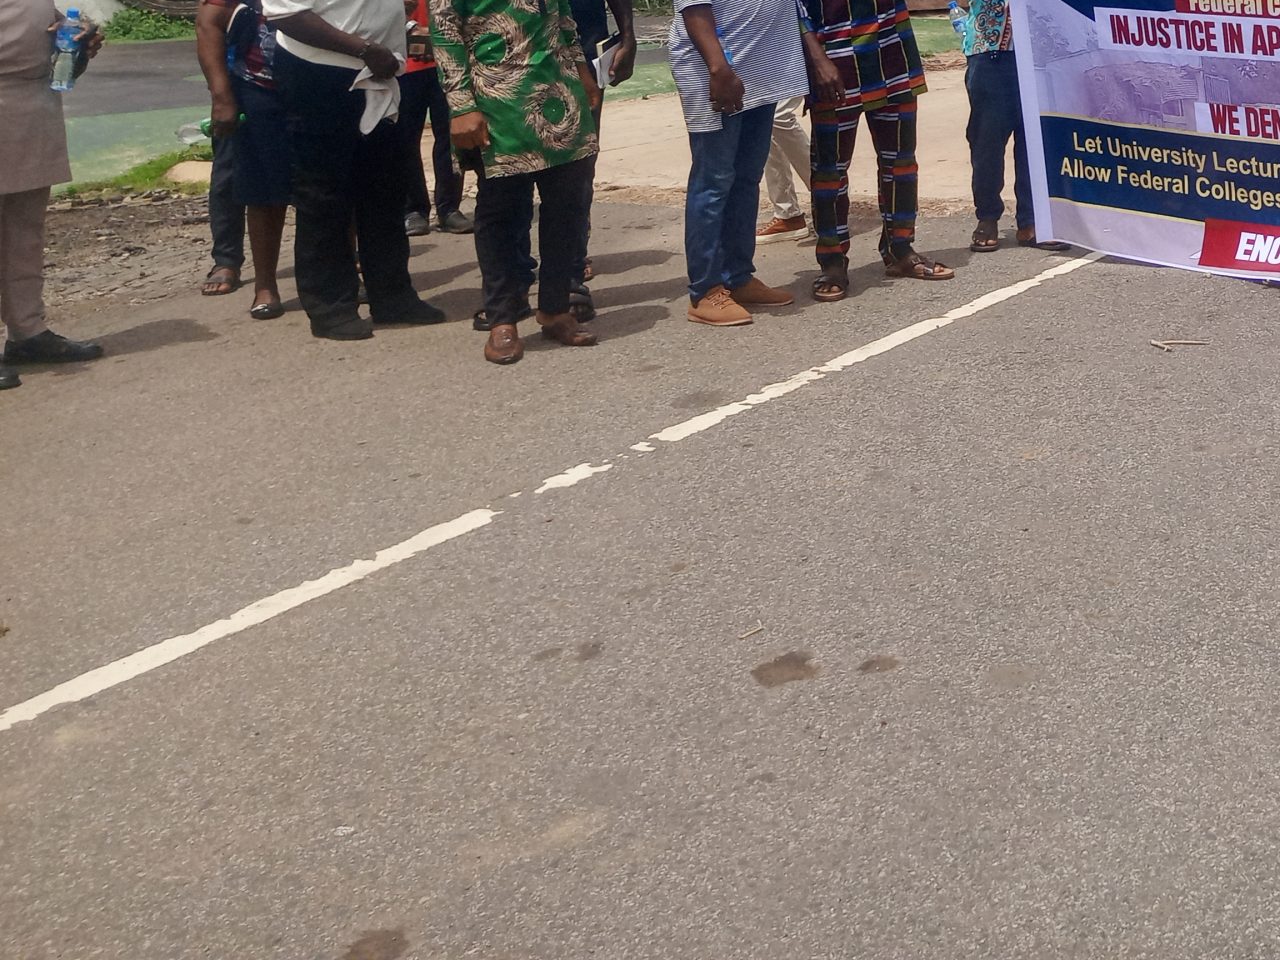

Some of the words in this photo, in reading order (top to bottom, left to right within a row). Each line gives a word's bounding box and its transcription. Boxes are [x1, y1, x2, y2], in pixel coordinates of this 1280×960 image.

[1110, 14, 1218, 52] INJUSTICE
[1222, 22, 1245, 54] IN
[1209, 102, 1241, 136] WE
[1073, 132, 1103, 155] Let
[1108, 136, 1207, 173] University
[1060, 157, 1111, 183] Allow
[1117, 165, 1190, 195] Federal
